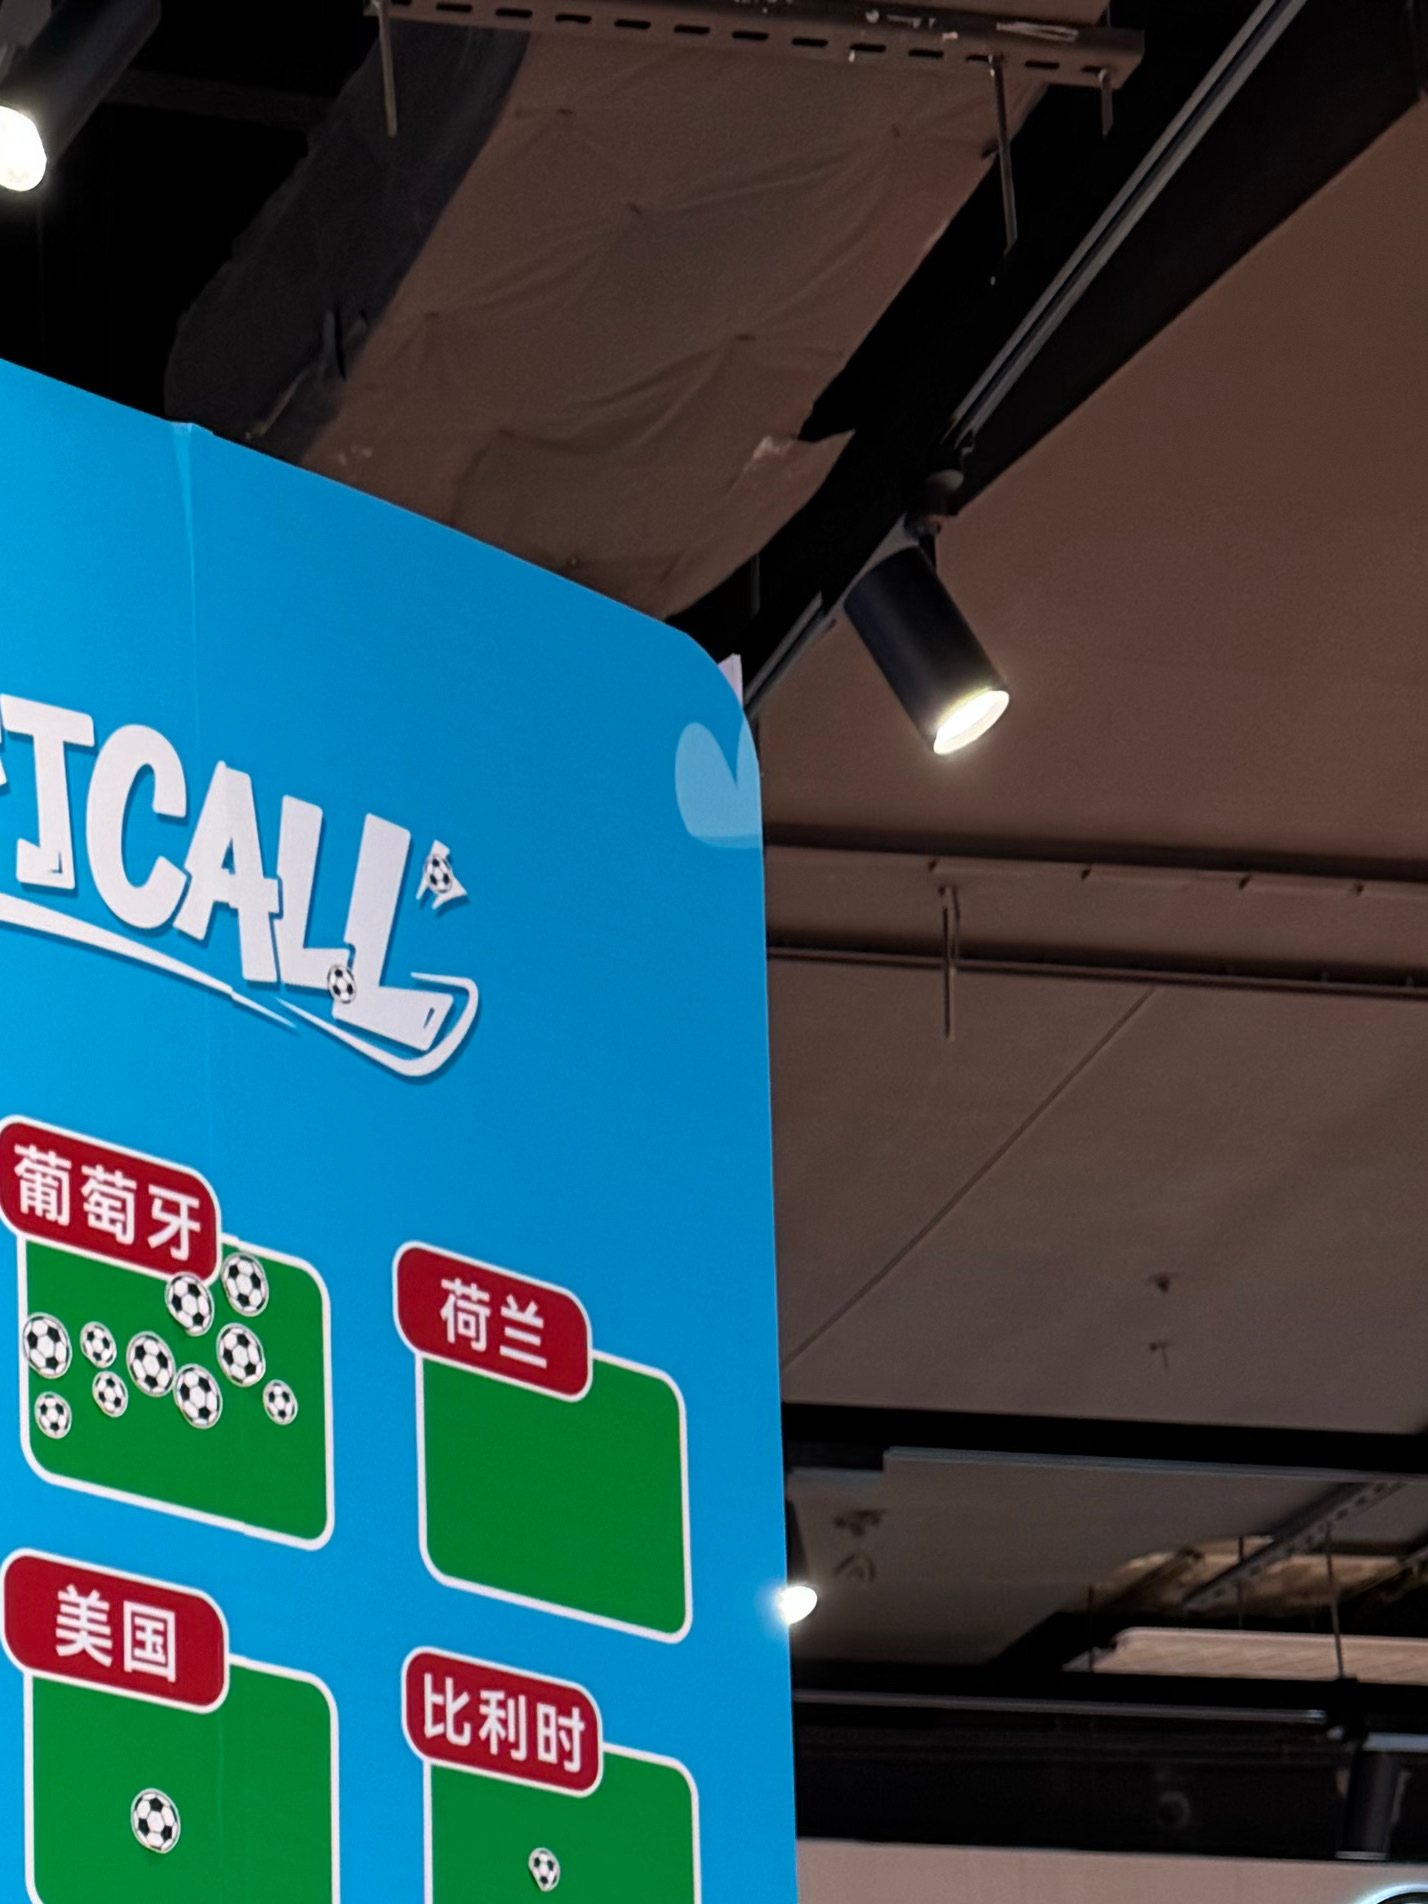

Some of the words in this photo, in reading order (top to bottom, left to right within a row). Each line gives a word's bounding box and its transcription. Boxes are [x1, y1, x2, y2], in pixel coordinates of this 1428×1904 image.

[15, 1145, 200, 1260] 葡萄牙
[441, 1279, 546, 1368] 荷兰
[56, 1585, 175, 1682] 美国
[424, 1673, 585, 1772] 比利时
